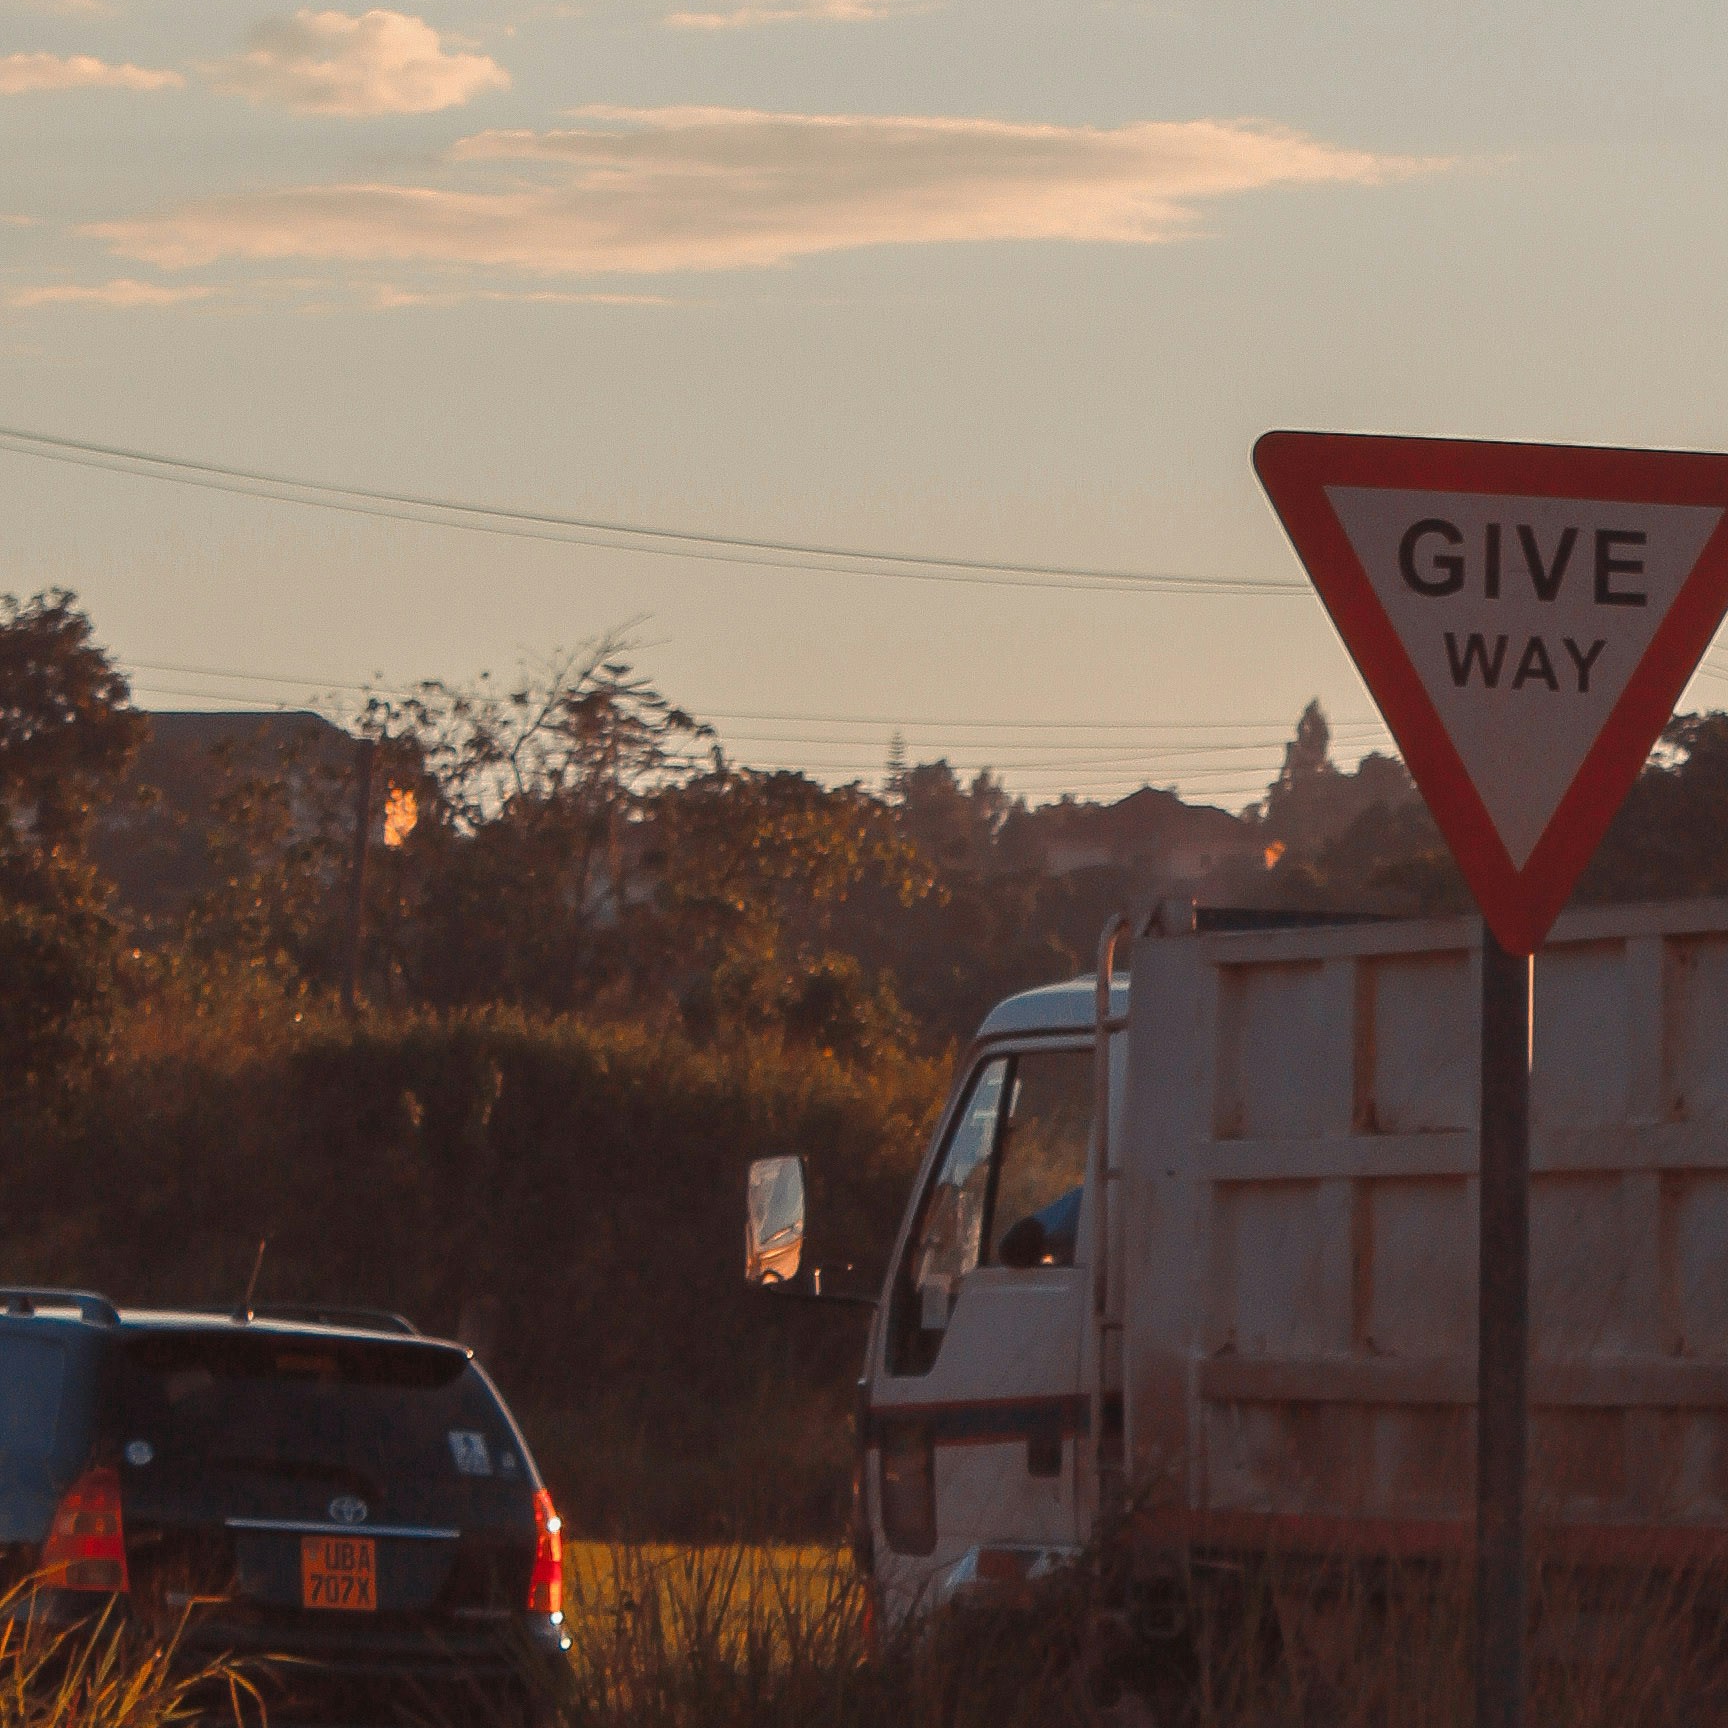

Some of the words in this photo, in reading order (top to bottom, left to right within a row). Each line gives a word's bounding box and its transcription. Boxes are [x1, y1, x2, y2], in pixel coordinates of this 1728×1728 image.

[1399, 517, 1648, 607] GIVE
[1444, 631, 1606, 693] WAY
[325, 1542, 371, 1571] UBA
[310, 1573, 370, 1604] 707X
